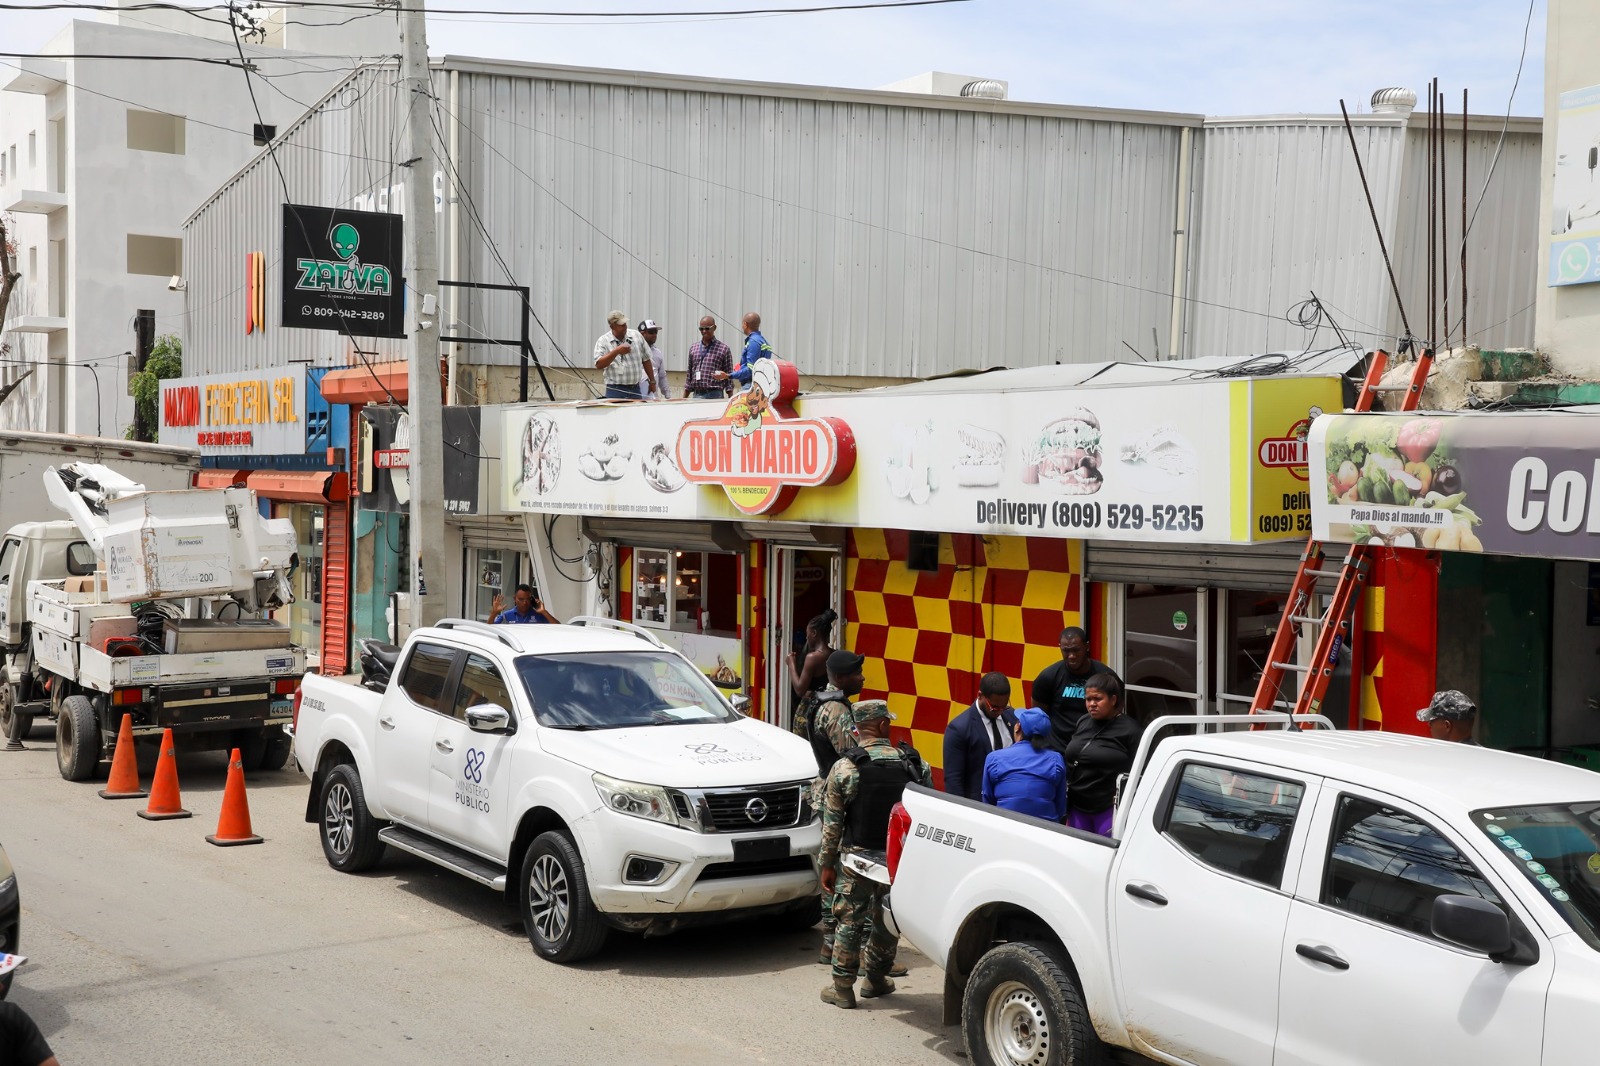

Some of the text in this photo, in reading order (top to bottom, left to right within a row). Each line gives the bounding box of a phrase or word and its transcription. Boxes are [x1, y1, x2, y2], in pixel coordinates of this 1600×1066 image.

[295, 258, 392, 296] ZATIVA
[273, 376, 297, 423] SRL
[690, 429, 817, 475] DON MARIO
[1268, 442, 1297, 462] DON
[742, 487, 768, 495] BENDECIDO
[976, 498, 1204, 532] Delivery (809) 529-5235
[1259, 513, 1293, 533] (809)
[1350, 508, 1443, 524] Papa Dios al mando..!!!
[199, 573, 214, 583] 200
[455, 779, 490, 800] MINISTERIO
[455, 791, 490, 814] PÚBLICO
[915, 823, 977, 853] DIESEL
